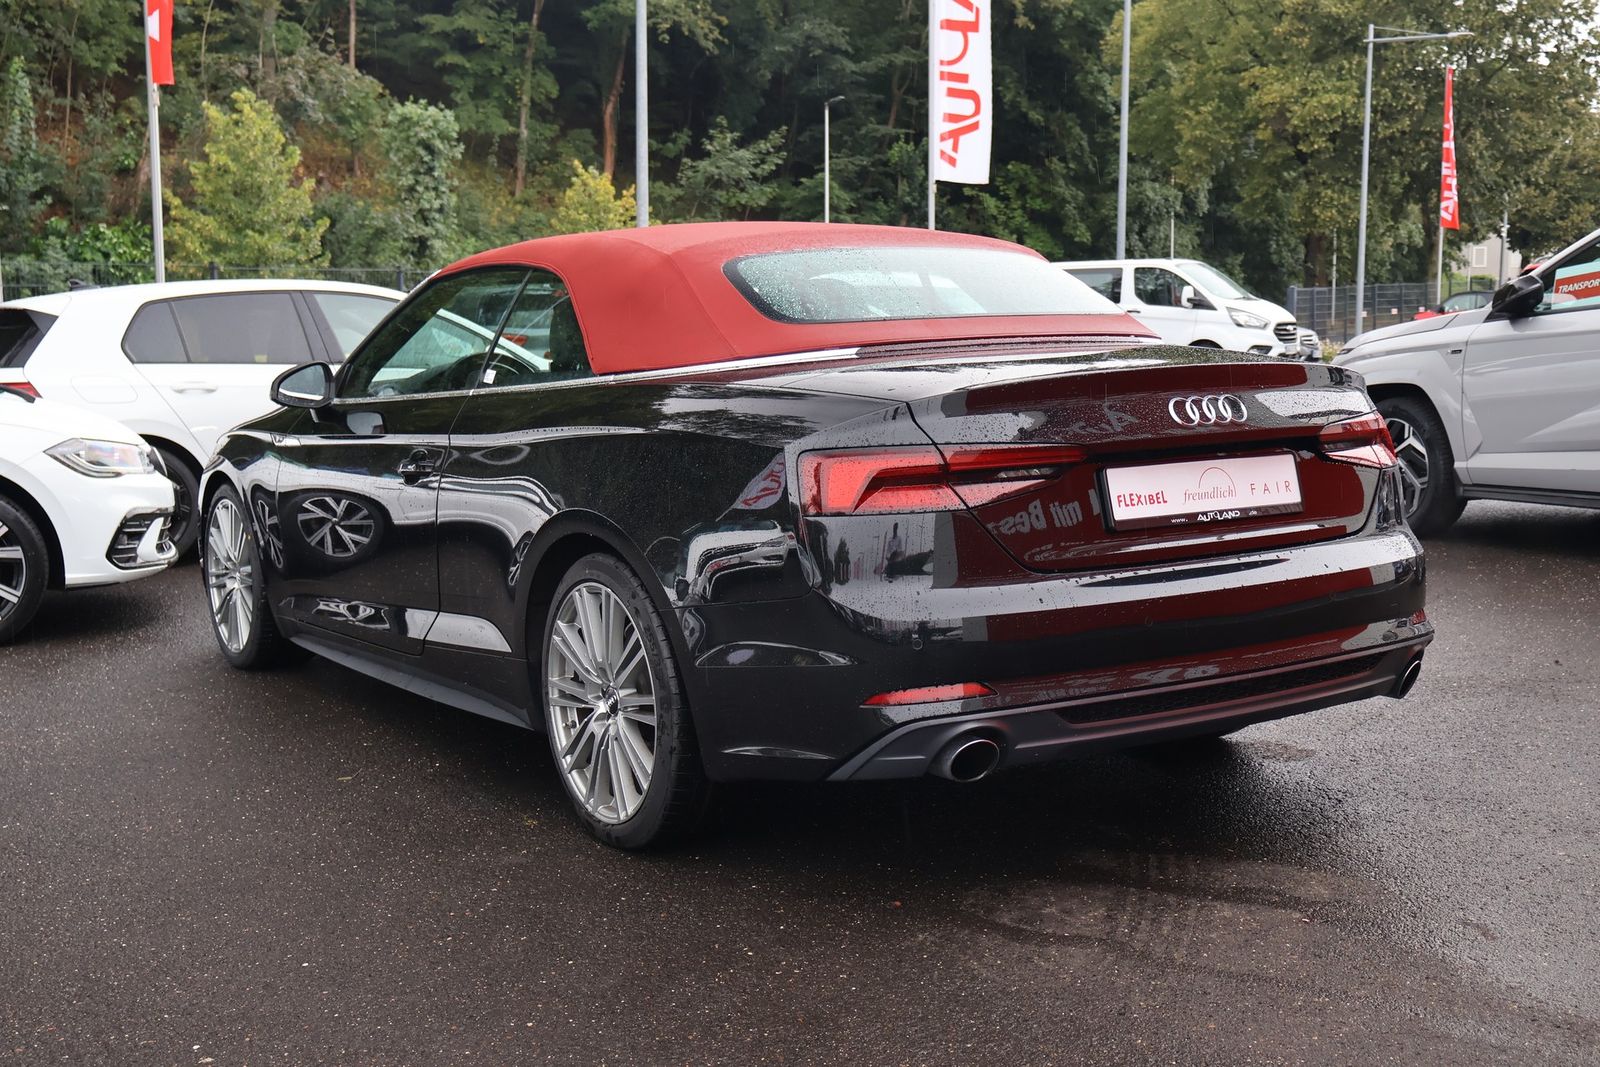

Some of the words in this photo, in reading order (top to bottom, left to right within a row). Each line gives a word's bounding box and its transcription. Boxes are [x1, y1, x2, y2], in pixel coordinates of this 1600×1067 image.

[1117, 490, 1168, 508] FLEXIBEL
[1183, 485, 1234, 505] freundlich
[1250, 480, 1292, 496] FAIR
[1197, 510, 1240, 522] AUTOLAND
